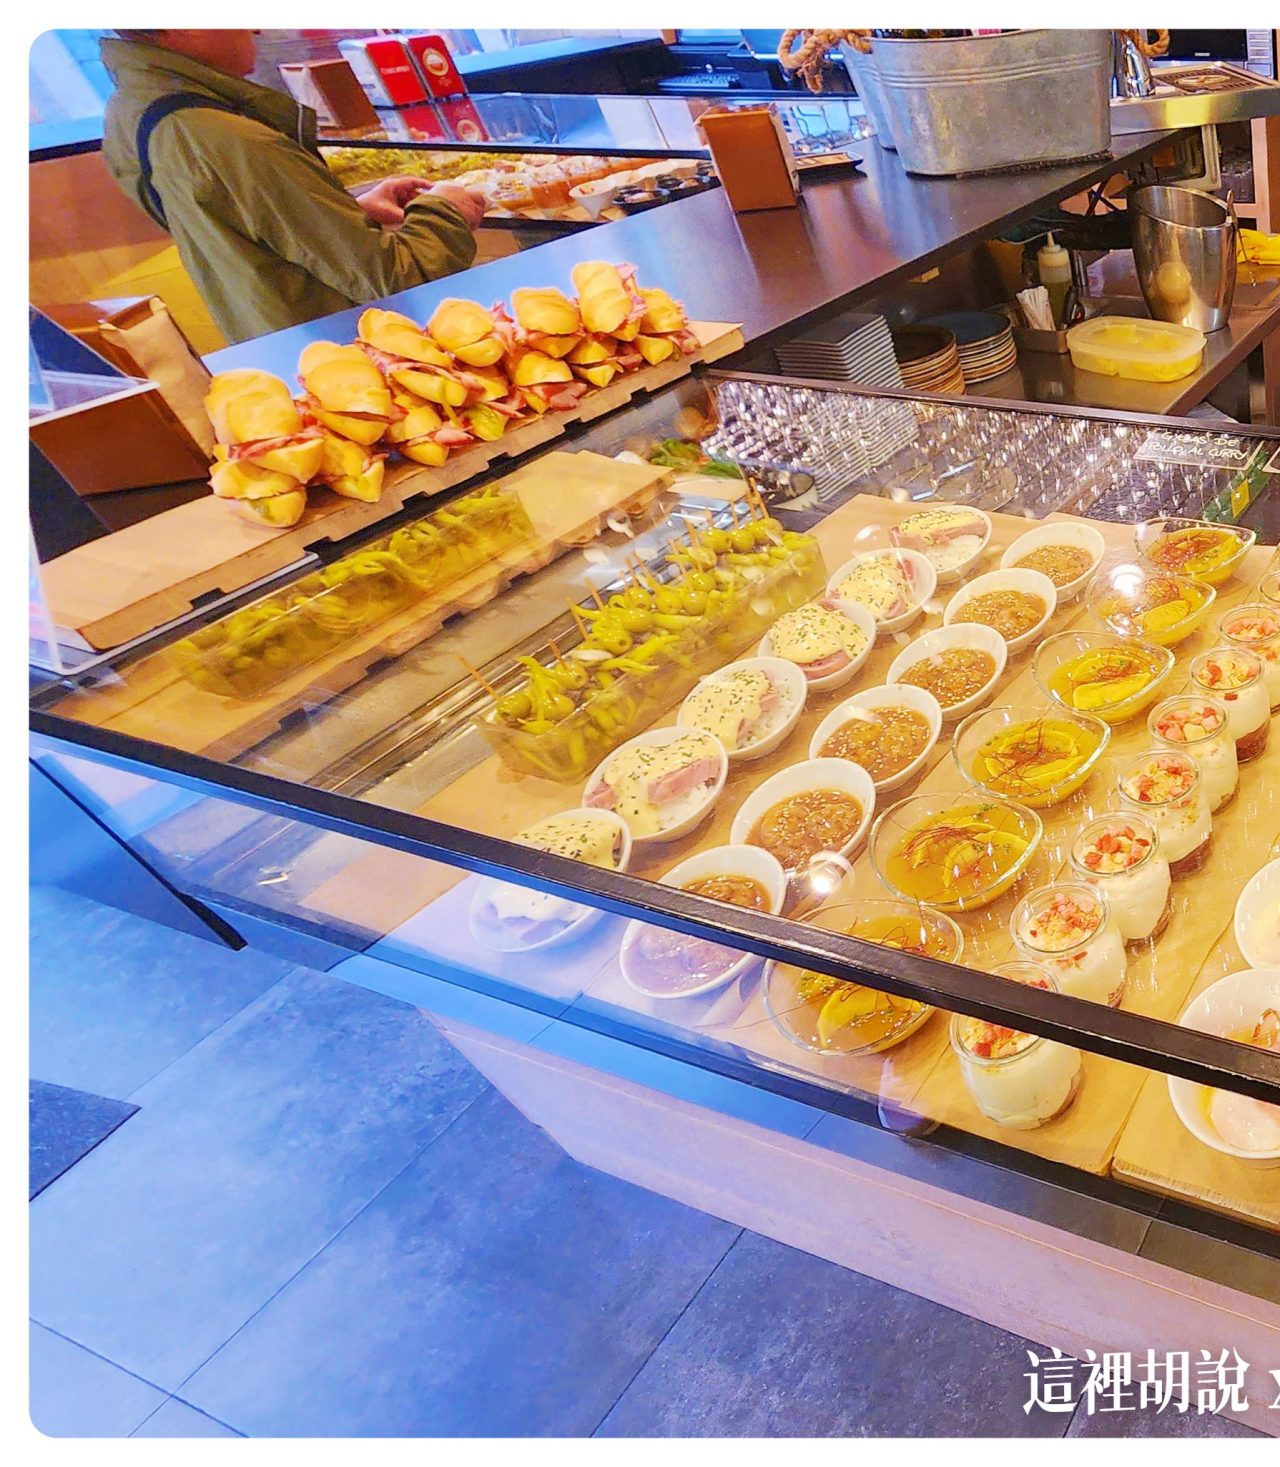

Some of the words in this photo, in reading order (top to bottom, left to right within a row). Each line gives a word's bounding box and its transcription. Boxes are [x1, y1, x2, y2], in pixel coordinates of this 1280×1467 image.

[1214, 437, 1241, 447] DE
[1188, 447, 1204, 455] AL
[1208, 448, 1248, 460] CURRY
